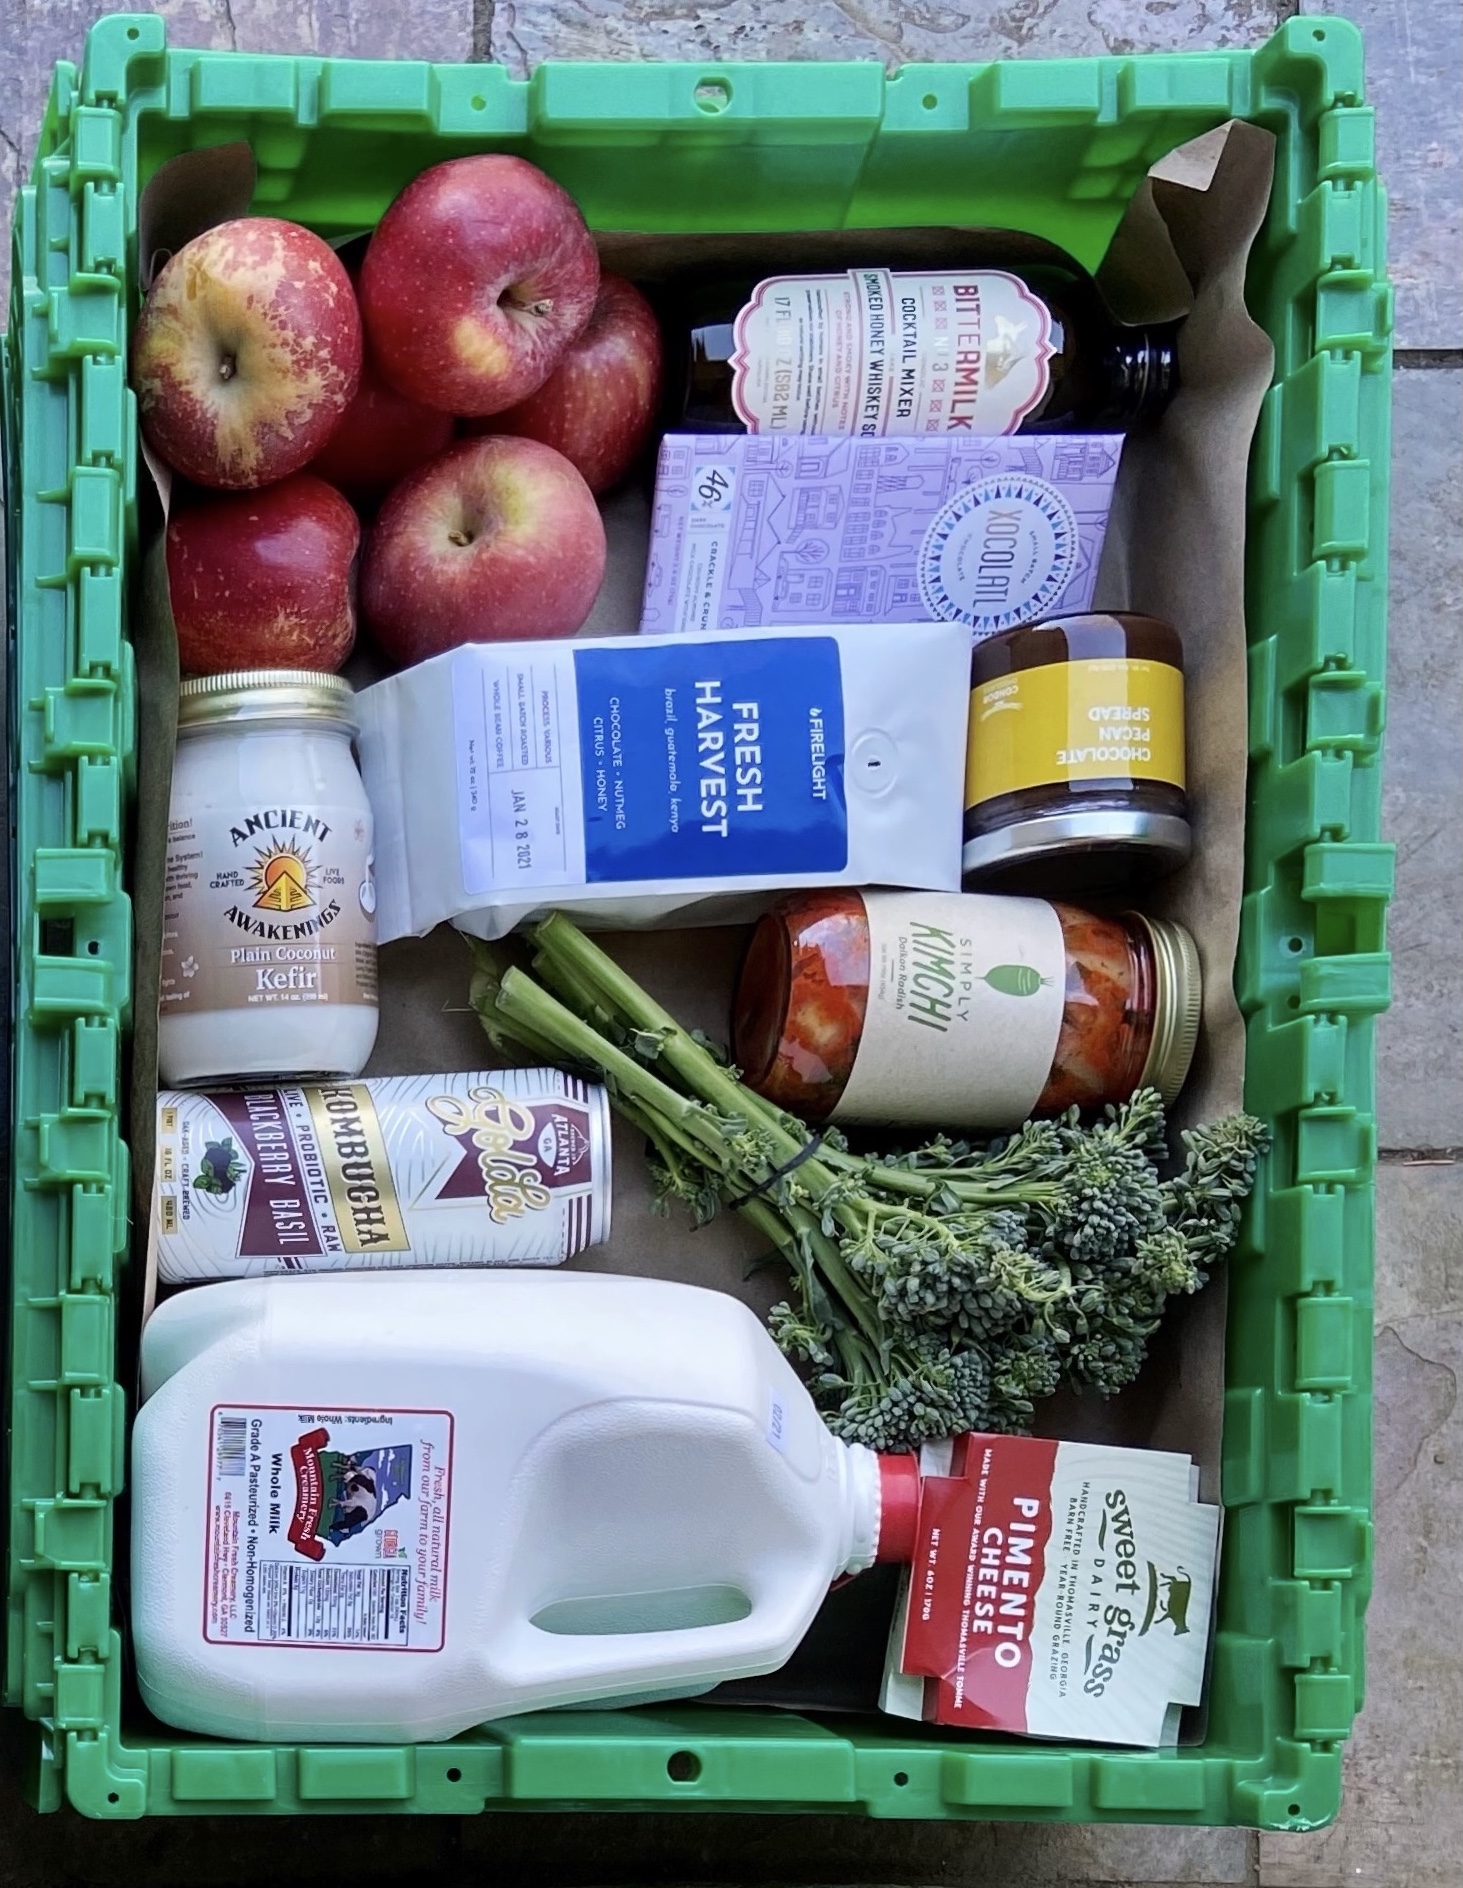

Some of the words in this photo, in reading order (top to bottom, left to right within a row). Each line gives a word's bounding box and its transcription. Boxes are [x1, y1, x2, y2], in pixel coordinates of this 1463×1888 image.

[774, 296, 790, 307] 17
[863, 273, 883, 311] SMOKED
[869, 314, 885, 355] HONEY
[901, 297, 917, 364] COCKTAIL
[844, 343, 853, 374] SMOKY
[947, 285, 981, 430] BITTERMILK
[832, 376, 841, 409] CITRUS
[842, 376, 852, 399] WITH
[864, 360, 884, 420] WHISKEY
[896, 368, 915, 418] MIXER
[770, 404, 788, 430] ML)
[838, 401, 848, 430] NOTES
[957, 532, 973, 582] CHOCOLATE
[973, 509, 1023, 607] XOCOLATL
[1028, 530, 1038, 555] SMALL
[705, 540, 718, 589] CRACKLE
[1020, 558, 1039, 585] BATCH
[704, 591, 712, 599] &
[700, 601, 711, 630] CRUN
[493, 679, 502, 711] WHOLE
[517, 673, 525, 700] SMALL
[541, 690, 551, 727] PROCESS
[664, 688, 678, 724] brazil,
[1088, 706, 1151, 721] SPREAD
[494, 713, 503, 735] BEAN
[593, 716, 604, 757] CITRUS
[609, 696, 623, 767] CHOCOLATE
[1099, 727, 1151, 742] PECAN
[495, 736, 504, 769] COFFEE
[520, 729, 529, 766] ROASTED
[665, 727, 682, 794] guatemala,
[694, 681, 729, 838] HARVEST
[732, 702, 763, 812] FRESH
[809, 718, 827, 800] FIRELIGHT
[1056, 747, 1151, 765] CHOCOLATE
[511, 790, 526, 813] JAN
[596, 769, 608, 812] HONEY
[614, 780, 626, 830] NUTMEG
[229, 809, 333, 847] ANCIENT
[515, 819, 528, 828] 2
[671, 798, 682, 833] kenya
[515, 831, 528, 840] 8
[325, 868, 341, 877] LIVE
[517, 844, 532, 870] 2021
[209, 879, 245, 889] CRAFTED
[216, 871, 239, 880] HAND
[223, 899, 342, 940] AWAKENINGS
[230, 946, 271, 963] Plain
[275, 946, 336, 961] Coconut
[898, 936, 908, 971] Daikon
[255, 966, 317, 991] Kefir
[895, 973, 907, 1010] Radish
[908, 921, 956, 1032] KIMCHI
[956, 938, 973, 1021] SIMPLY
[247, 994, 264, 1003] NET
[280, 993, 289, 1001] 14
[244, 1094, 296, 1186] BLACKBERRY
[425, 1086, 552, 1225] Golda
[542, 1137, 553, 1153] GA
[551, 1114, 571, 1176] ATLANTA
[164, 1157, 172, 1167] FL
[164, 1169, 172, 1179] OZ
[283, 1088, 303, 1108] LIVE
[296, 1125, 329, 1204] PROBIOTIC
[321, 1225, 343, 1252] RAW
[318, 1088, 391, 1247] KOMBUCHA
[269, 1199, 310, 1245] BASIL
[250, 1418, 263, 1452] Grade
[298, 1414, 315, 1424] Milk
[317, 1414, 343, 1424] Whole
[345, 1414, 393, 1426] Ingredients:
[250, 1454, 262, 1462] A
[420, 1439, 434, 1473] from
[980, 1448, 993, 1475] MADE
[269, 1453, 283, 1499] Whole
[303, 1447, 320, 1506] Mountain
[420, 1474, 431, 1498] our
[432, 1465, 446, 1504] Fresh,
[977, 1478, 989, 1503] WITH
[247, 1464, 262, 1526] Pasteurized
[295, 1467, 309, 1523] Creamery
[1066, 1497, 1078, 1526] BARN
[268, 1502, 281, 1534] Milk
[300, 1508, 318, 1541] Fresh
[419, 1499, 432, 1531] farm
[432, 1507, 441, 1523] all
[973, 1505, 986, 1526] OUR
[1072, 1481, 1091, 1556] HANDCRAFTED
[375, 1529, 383, 1559] grown
[418, 1533, 429, 1546] to
[431, 1525, 441, 1572] natural
[931, 1528, 941, 1546] NET
[968, 1528, 982, 1562] AWARD
[1062, 1528, 1073, 1552] FREE
[1105, 1489, 1141, 1596] sweet
[231, 1545, 240, 1566] Fresh
[416, 1547, 428, 1578] your
[1071, 1559, 1080, 1571] IN
[243, 1536, 258, 1633] Non-Homogenized
[400, 1568, 408, 1608] Nutrition
[429, 1574, 441, 1602] milk
[962, 1564, 975, 1606] WINNING
[972, 1527, 1003, 1635] CHEESE
[994, 1497, 1040, 1668] PIMENTO
[1053, 1563, 1069, 1630] YEAR-ROUND
[1086, 1558, 1106, 1629] DAIRY
[221, 1603, 228, 1616] GA
[229, 1604, 237, 1619] LLC
[413, 1577, 429, 1625] family!
[399, 1609, 407, 1634] Facts
[956, 1609, 971, 1673] THOMASVILLE
[1049, 1634, 1061, 1681] GRAZING
[1083, 1604, 1135, 1698] grass
[953, 1674, 966, 1709] TOMME
[1058, 1652, 1070, 1698] GEORGIA
